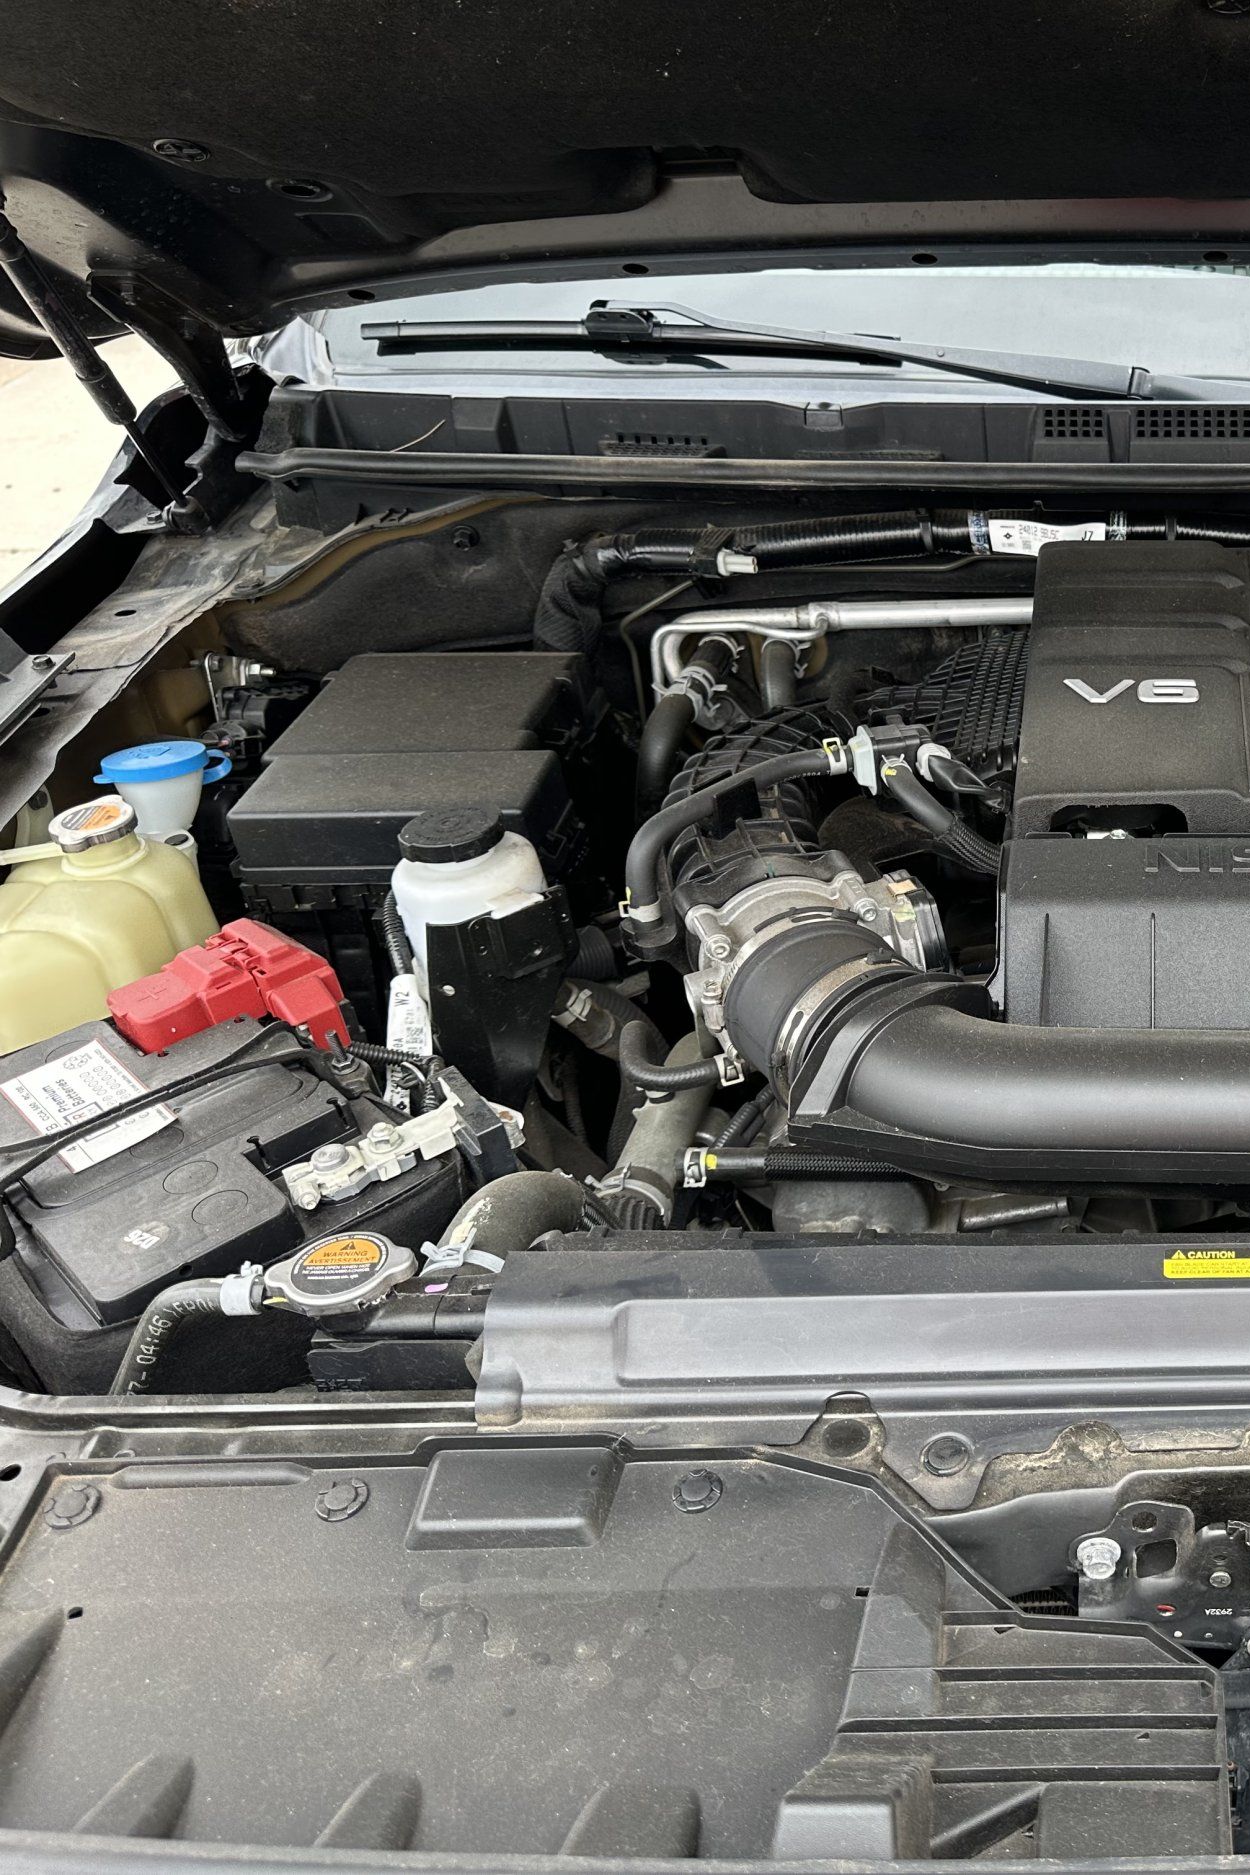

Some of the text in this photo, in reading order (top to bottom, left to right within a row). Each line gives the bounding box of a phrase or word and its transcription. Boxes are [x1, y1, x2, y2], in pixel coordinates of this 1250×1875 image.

[1063, 679, 1199, 703] V6
[394, 991, 410, 1007] W2
[42, 1086, 73, 1114] Premium
[55, 1078, 86, 1107] Batteries
[1187, 1251, 1236, 1259] CAUTION
[1204, 1608, 1233, 1616] 2932A
